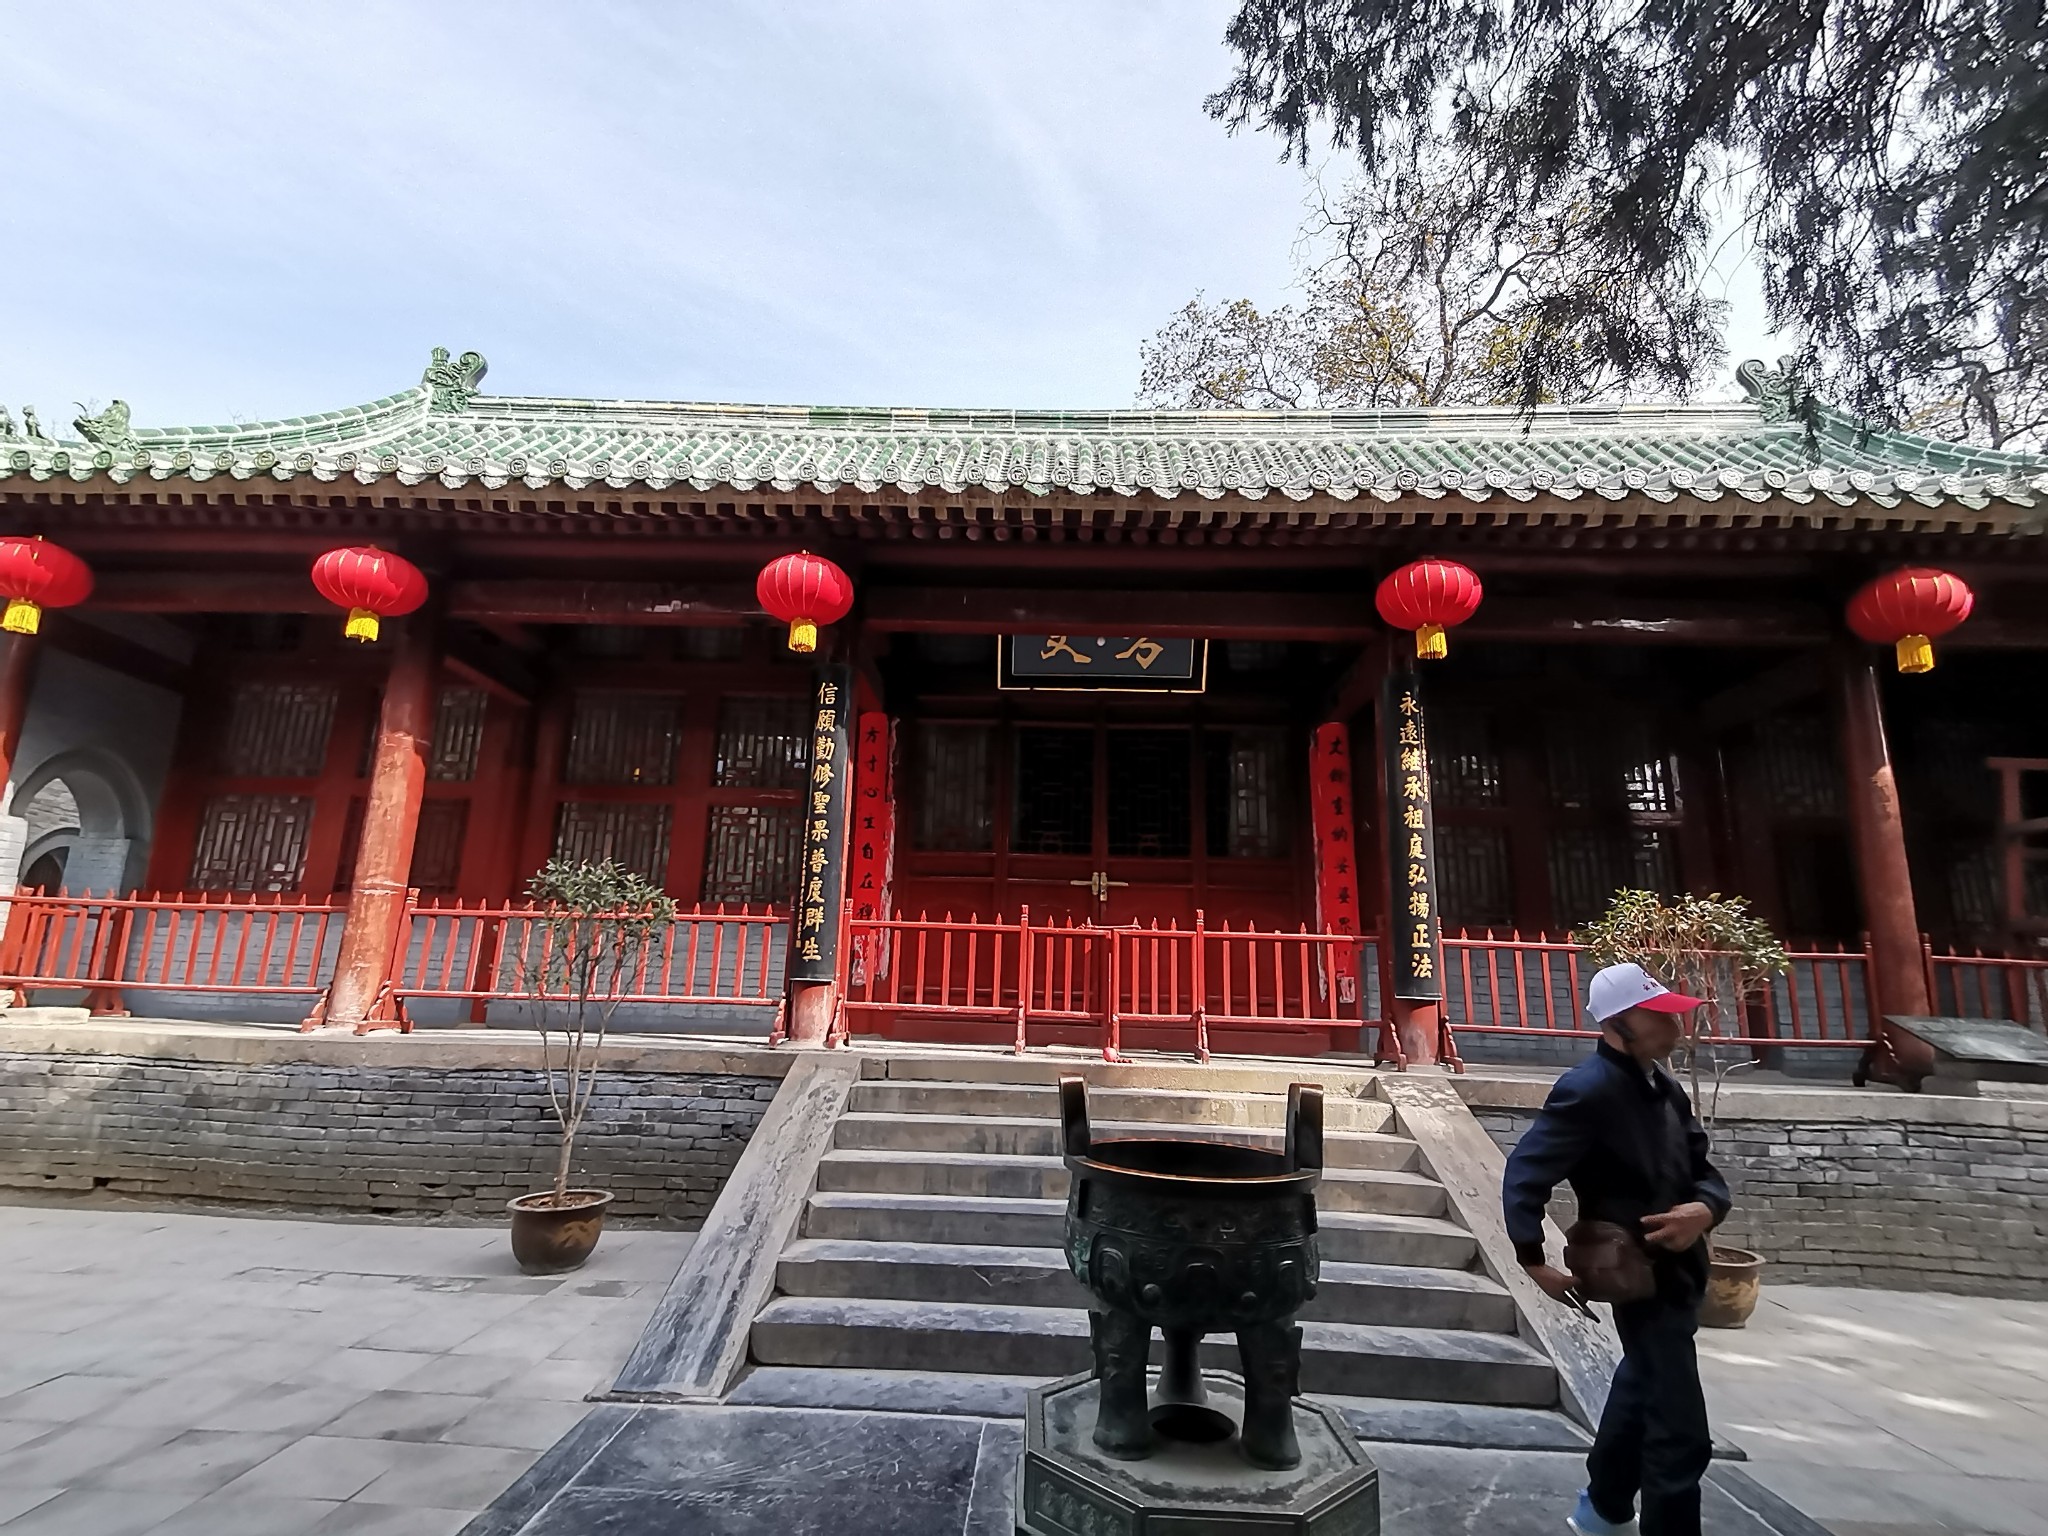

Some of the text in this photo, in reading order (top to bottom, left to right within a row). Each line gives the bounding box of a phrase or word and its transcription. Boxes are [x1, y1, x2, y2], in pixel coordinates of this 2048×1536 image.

[1400, 691, 1434, 979] 永遠繼承祖庭弘揚正法
